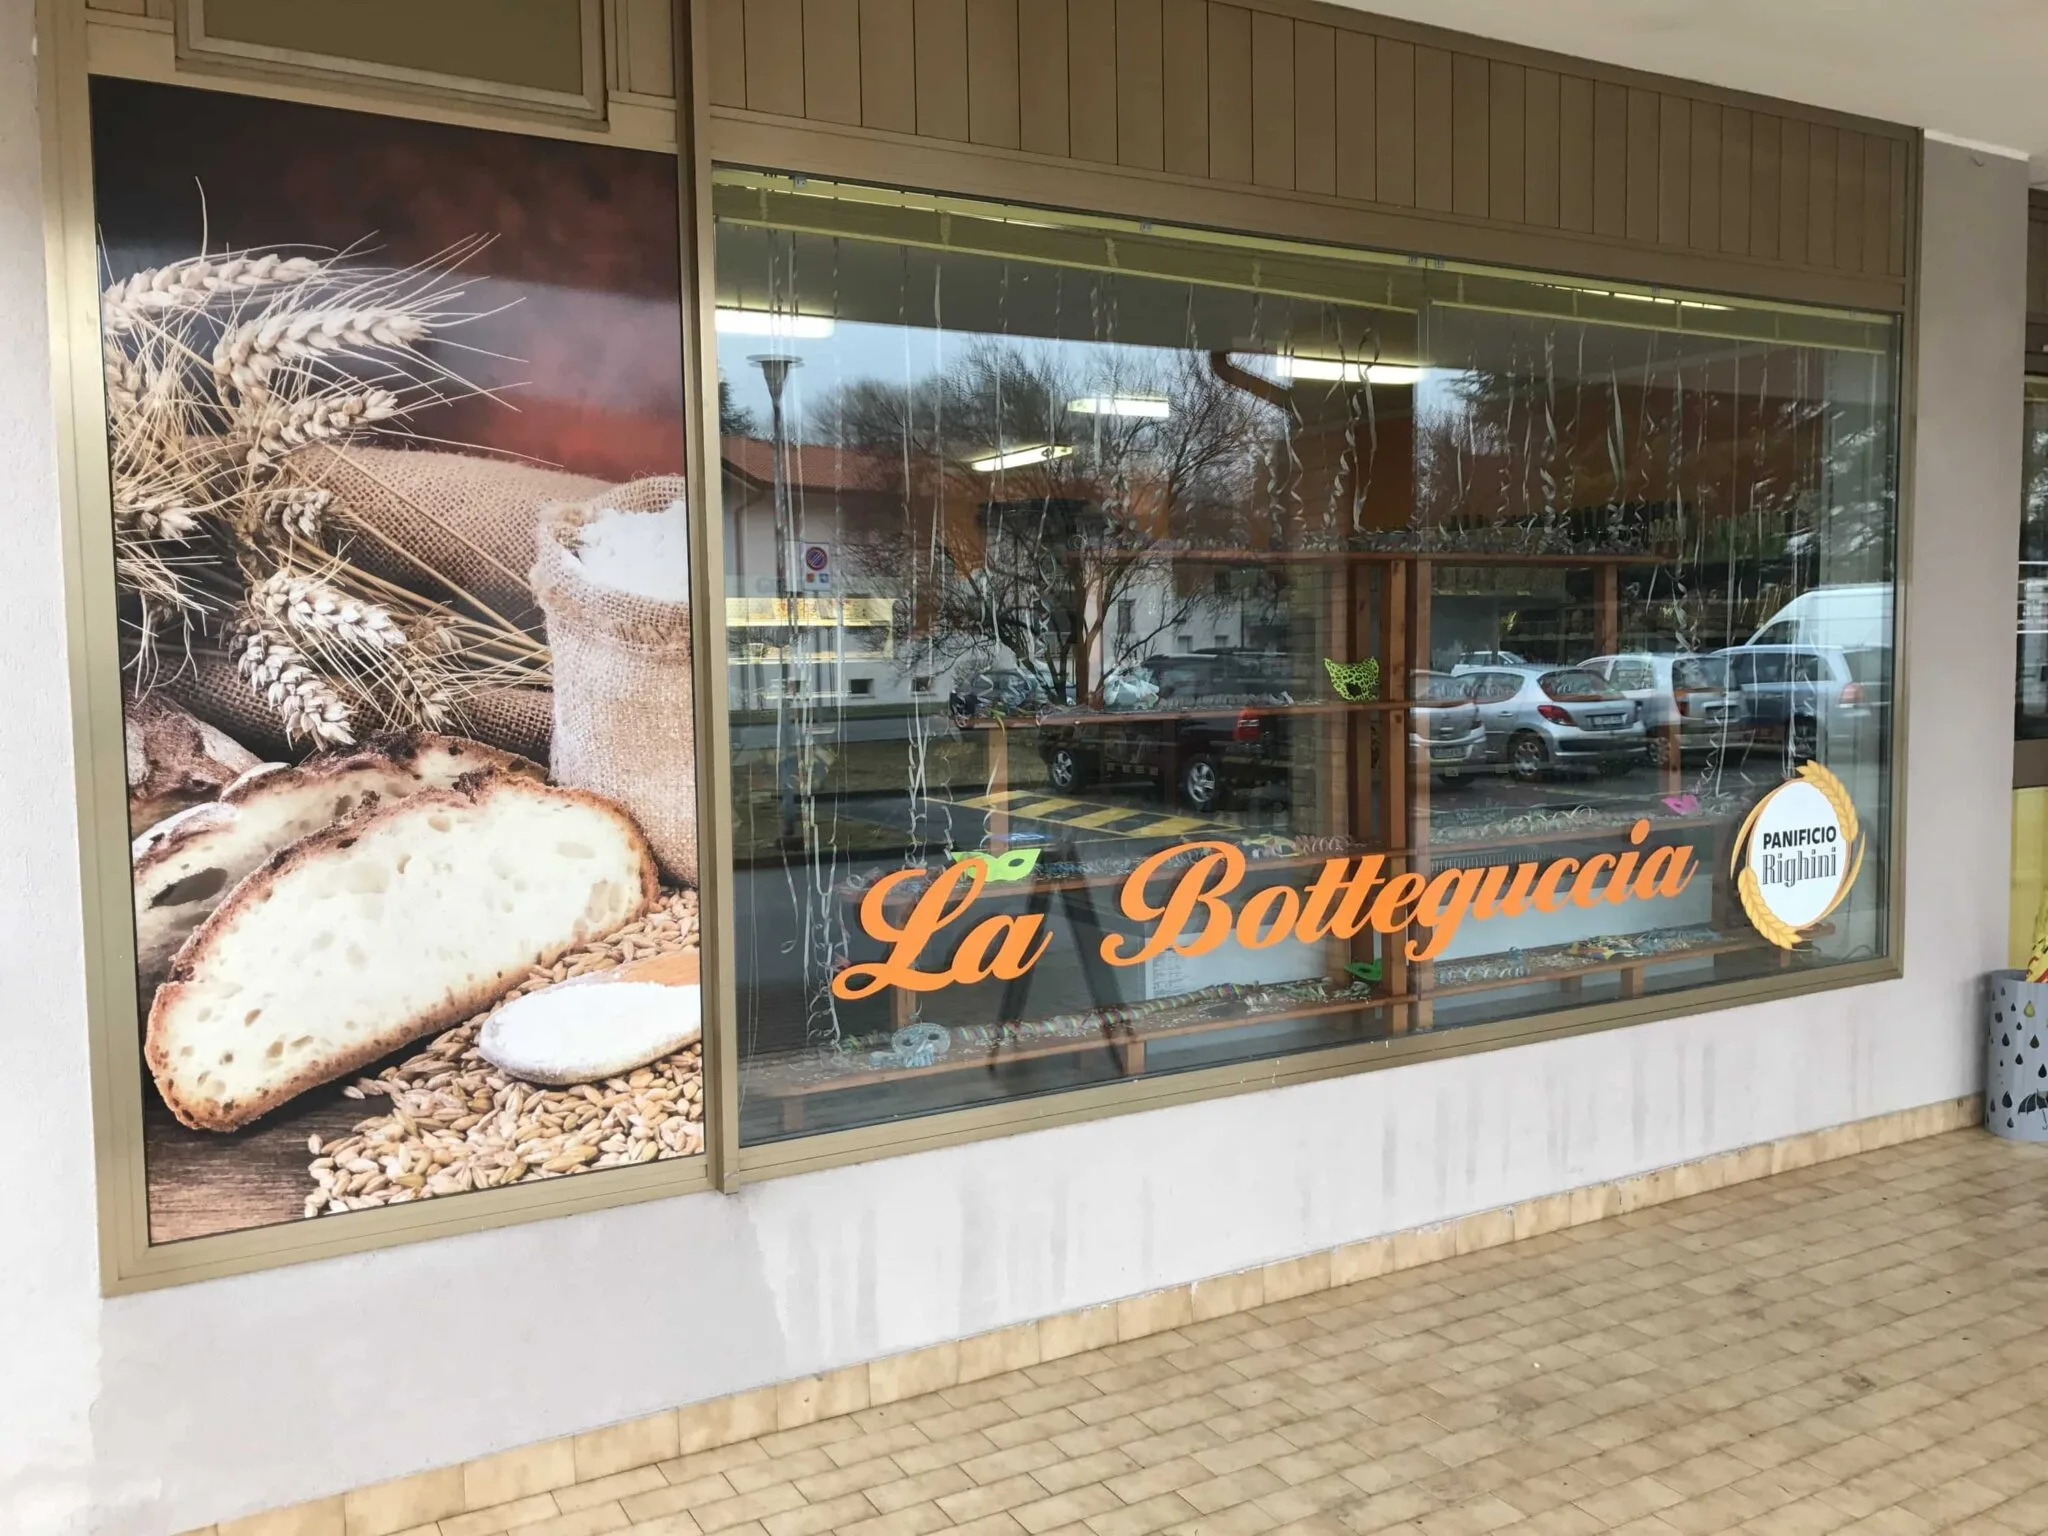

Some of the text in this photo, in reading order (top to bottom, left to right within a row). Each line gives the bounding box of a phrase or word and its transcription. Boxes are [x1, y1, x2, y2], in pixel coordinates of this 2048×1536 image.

[1762, 825, 1837, 850] PANIFICIO
[1761, 846, 1837, 888] Righini
[832, 819, 1699, 1001] La Botteguccia
